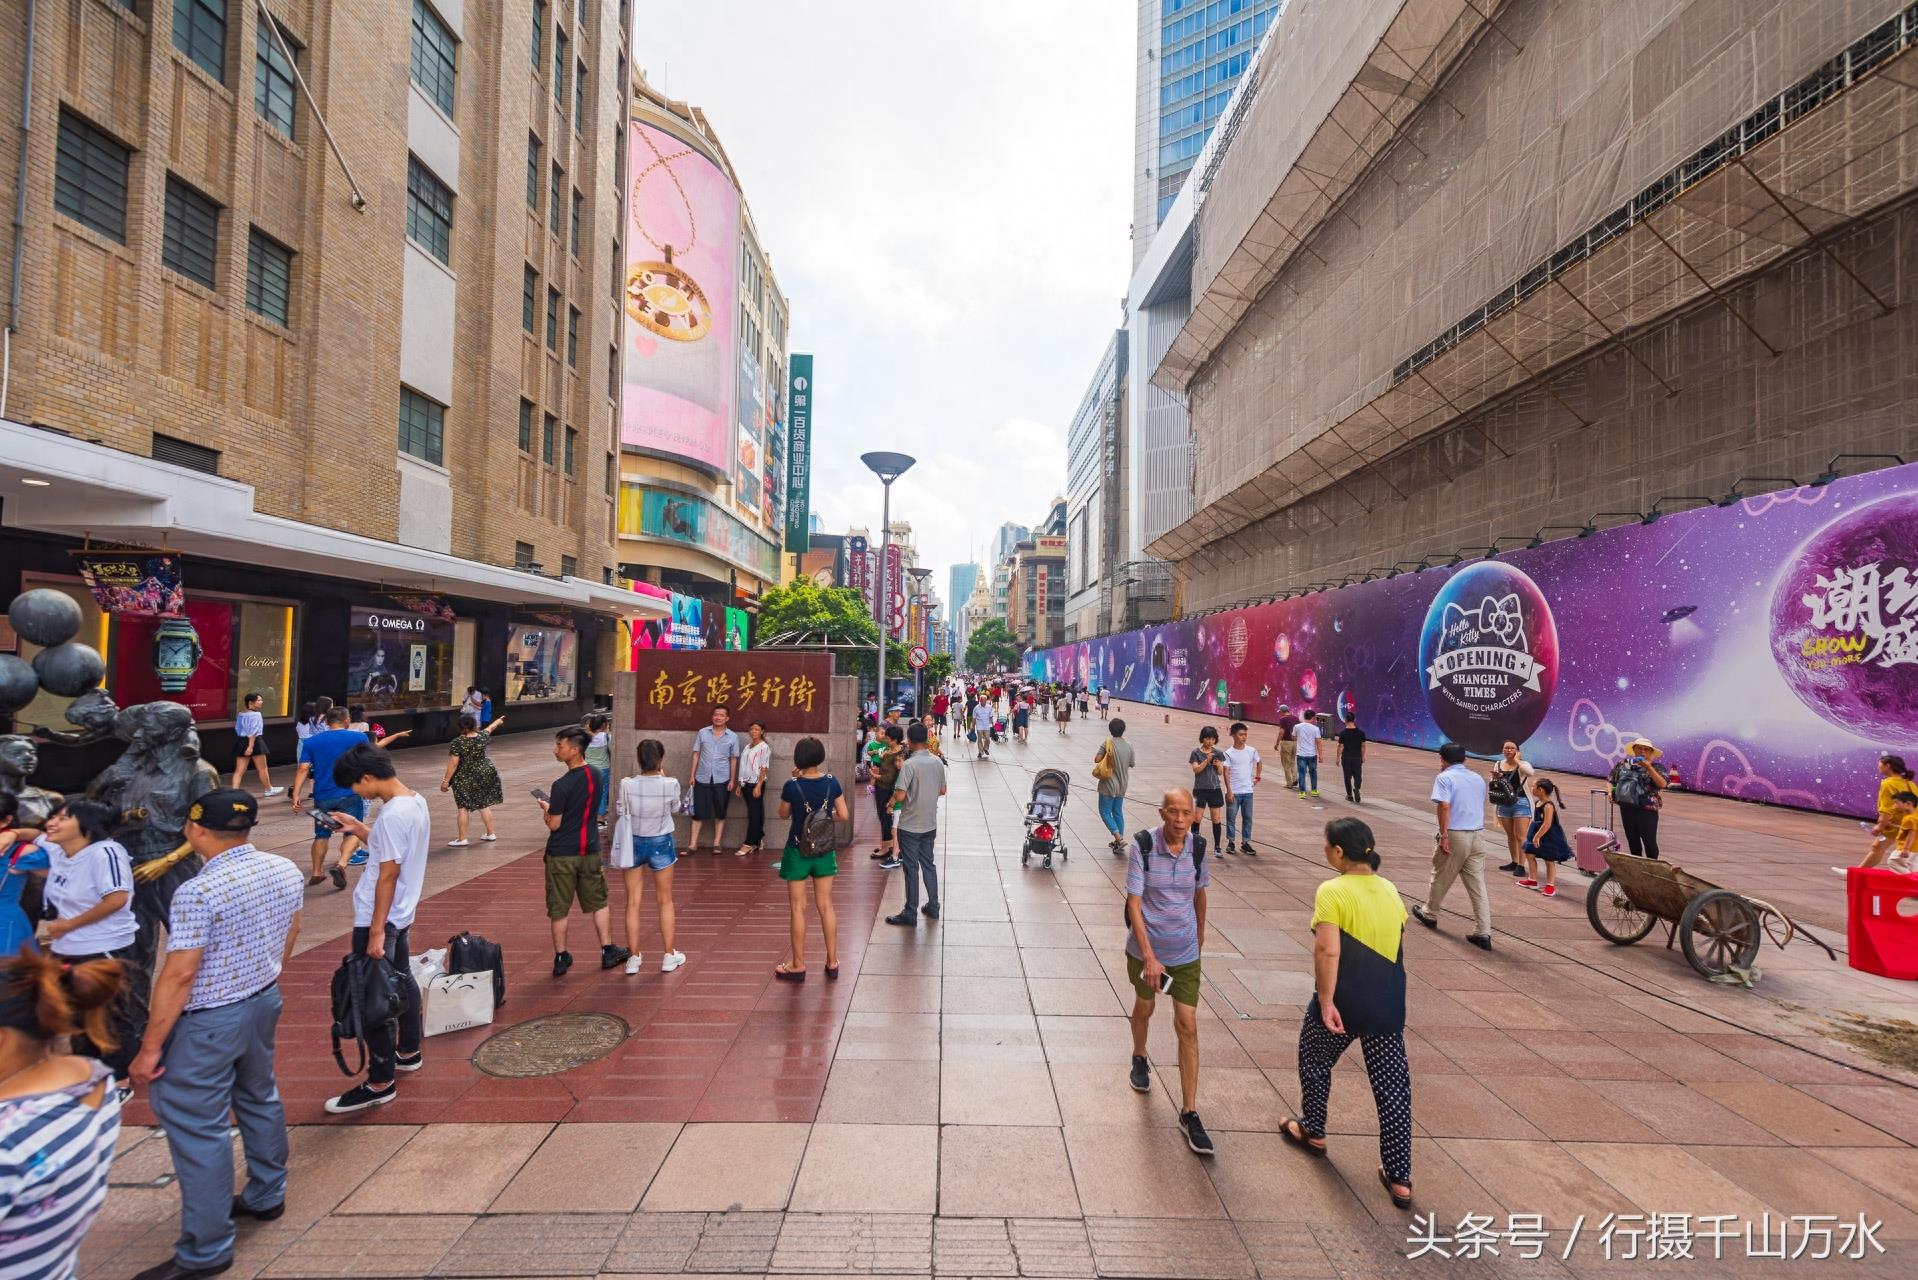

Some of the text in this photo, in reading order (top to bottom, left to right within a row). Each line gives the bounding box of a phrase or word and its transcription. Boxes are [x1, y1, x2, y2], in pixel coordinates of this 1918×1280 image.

[382, 618, 413, 630] OMEGA
[1449, 619, 1470, 637] Hello
[1460, 628, 1480, 645] Kitty
[1802, 634, 1868, 657] SHOW
[244, 655, 279, 667] Cartier
[1447, 651, 1516, 670] OPENING
[1831, 654, 1862, 666] MORE
[1453, 674, 1509, 686] SHANGHAI
[649, 670, 817, 713] 南京路步行街
[1442, 686, 1523, 712] WITH SANRIO CHARACTERS
[1464, 687, 1497, 699] TIMES
